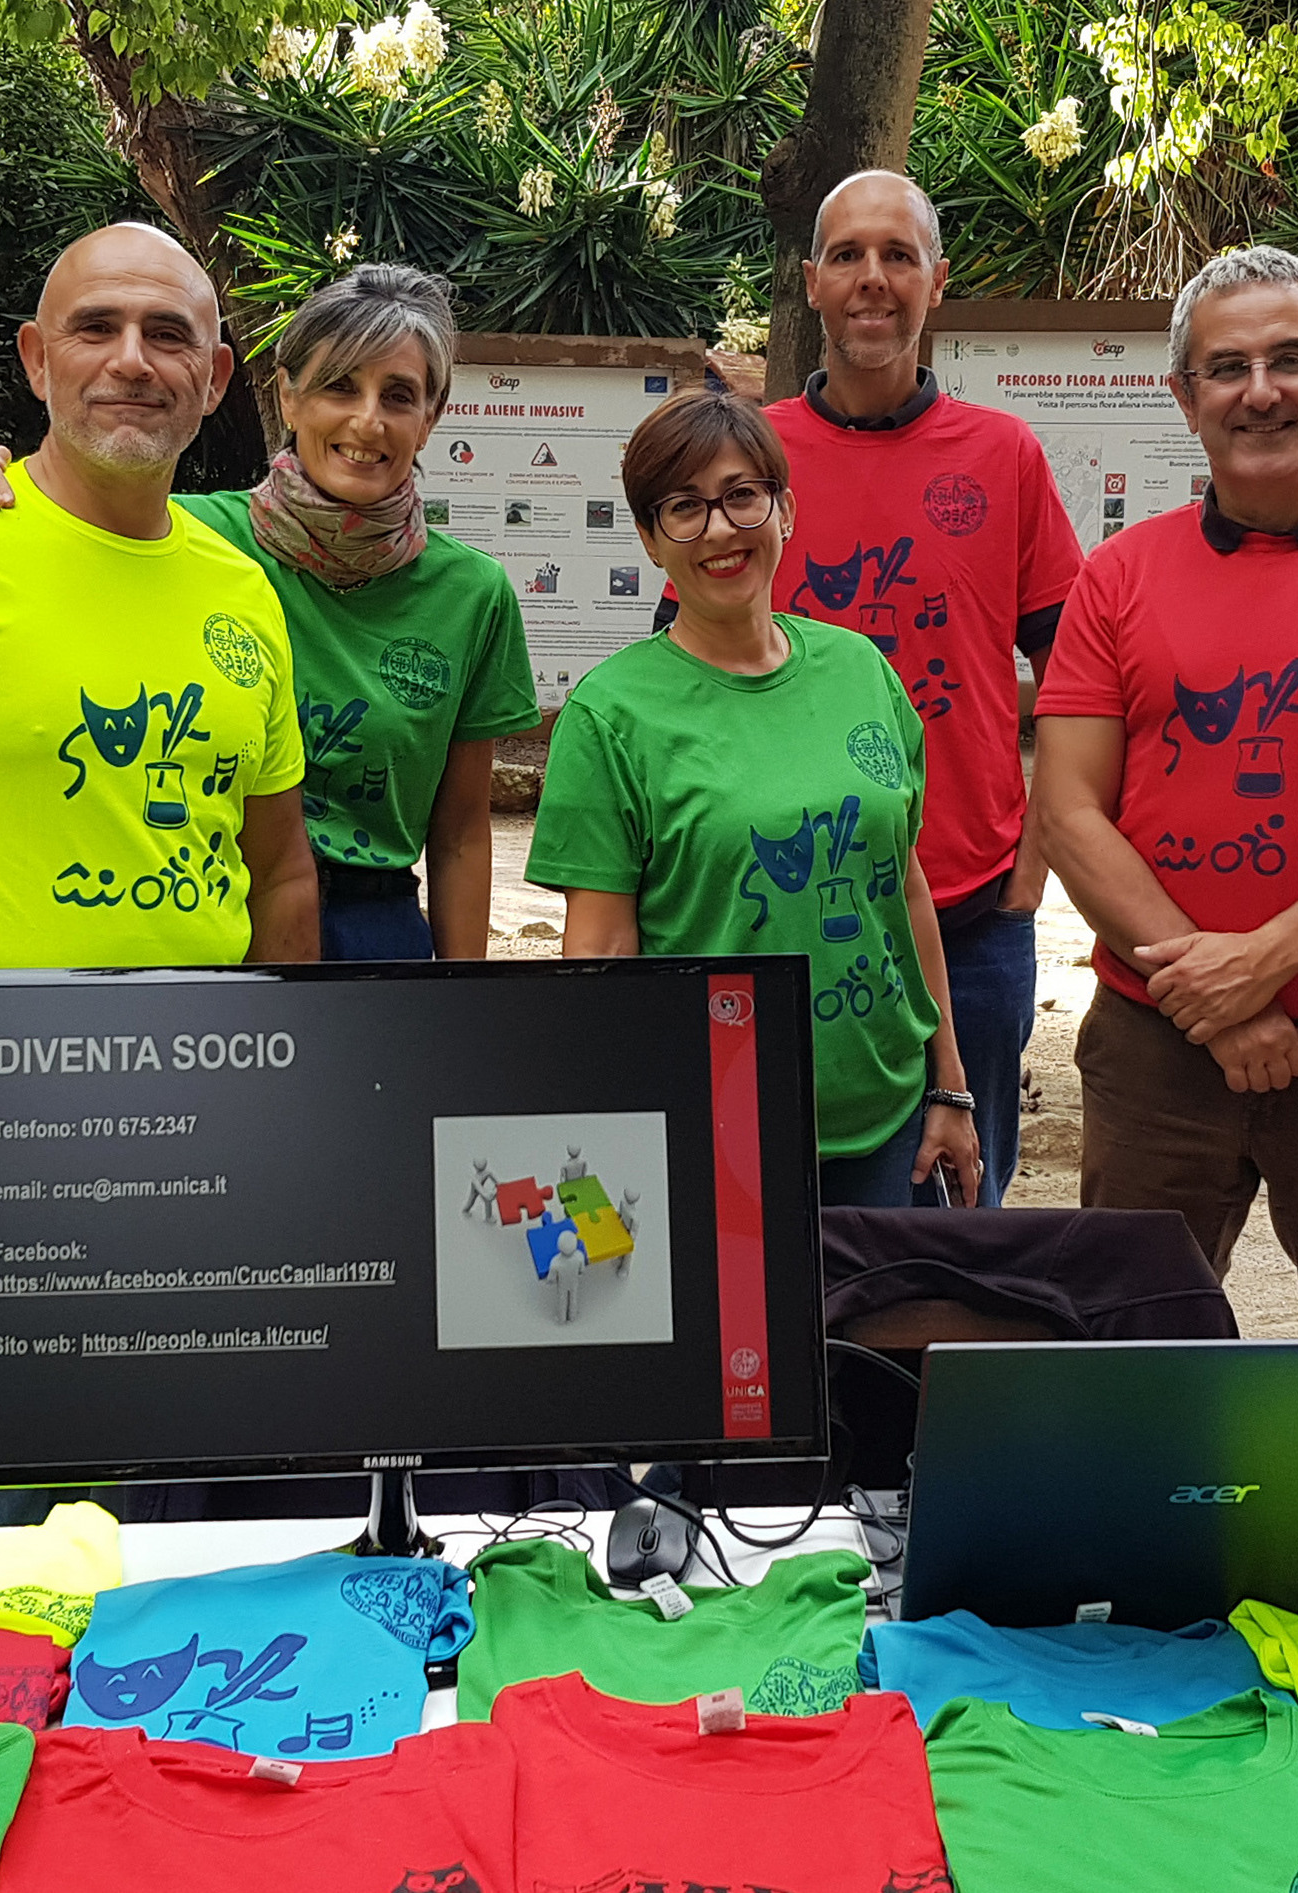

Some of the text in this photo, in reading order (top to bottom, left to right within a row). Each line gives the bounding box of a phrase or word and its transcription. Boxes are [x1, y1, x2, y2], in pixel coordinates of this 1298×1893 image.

[997, 374, 1061, 386] PERCORSO
[1066, 374, 1106, 386] FLORA
[1110, 374, 1155, 387] ALIENA
[484, 404, 525, 417] ALIENE
[530, 405, 584, 418] INVASIVE
[172, 1031, 296, 1070] SOCIO
[81, 1118, 114, 1137] 070
[118, 1115, 198, 1136] 675.2347
[52, 1175, 227, 1202] cruc@amm.unica.it
[33, 1334, 76, 1354] web:
[82, 1324, 329, 1357] https://people.unica.it/cruc/
[363, 1455, 422, 1469] SAMSUNG
[1169, 1485, 1260, 1503] acer
